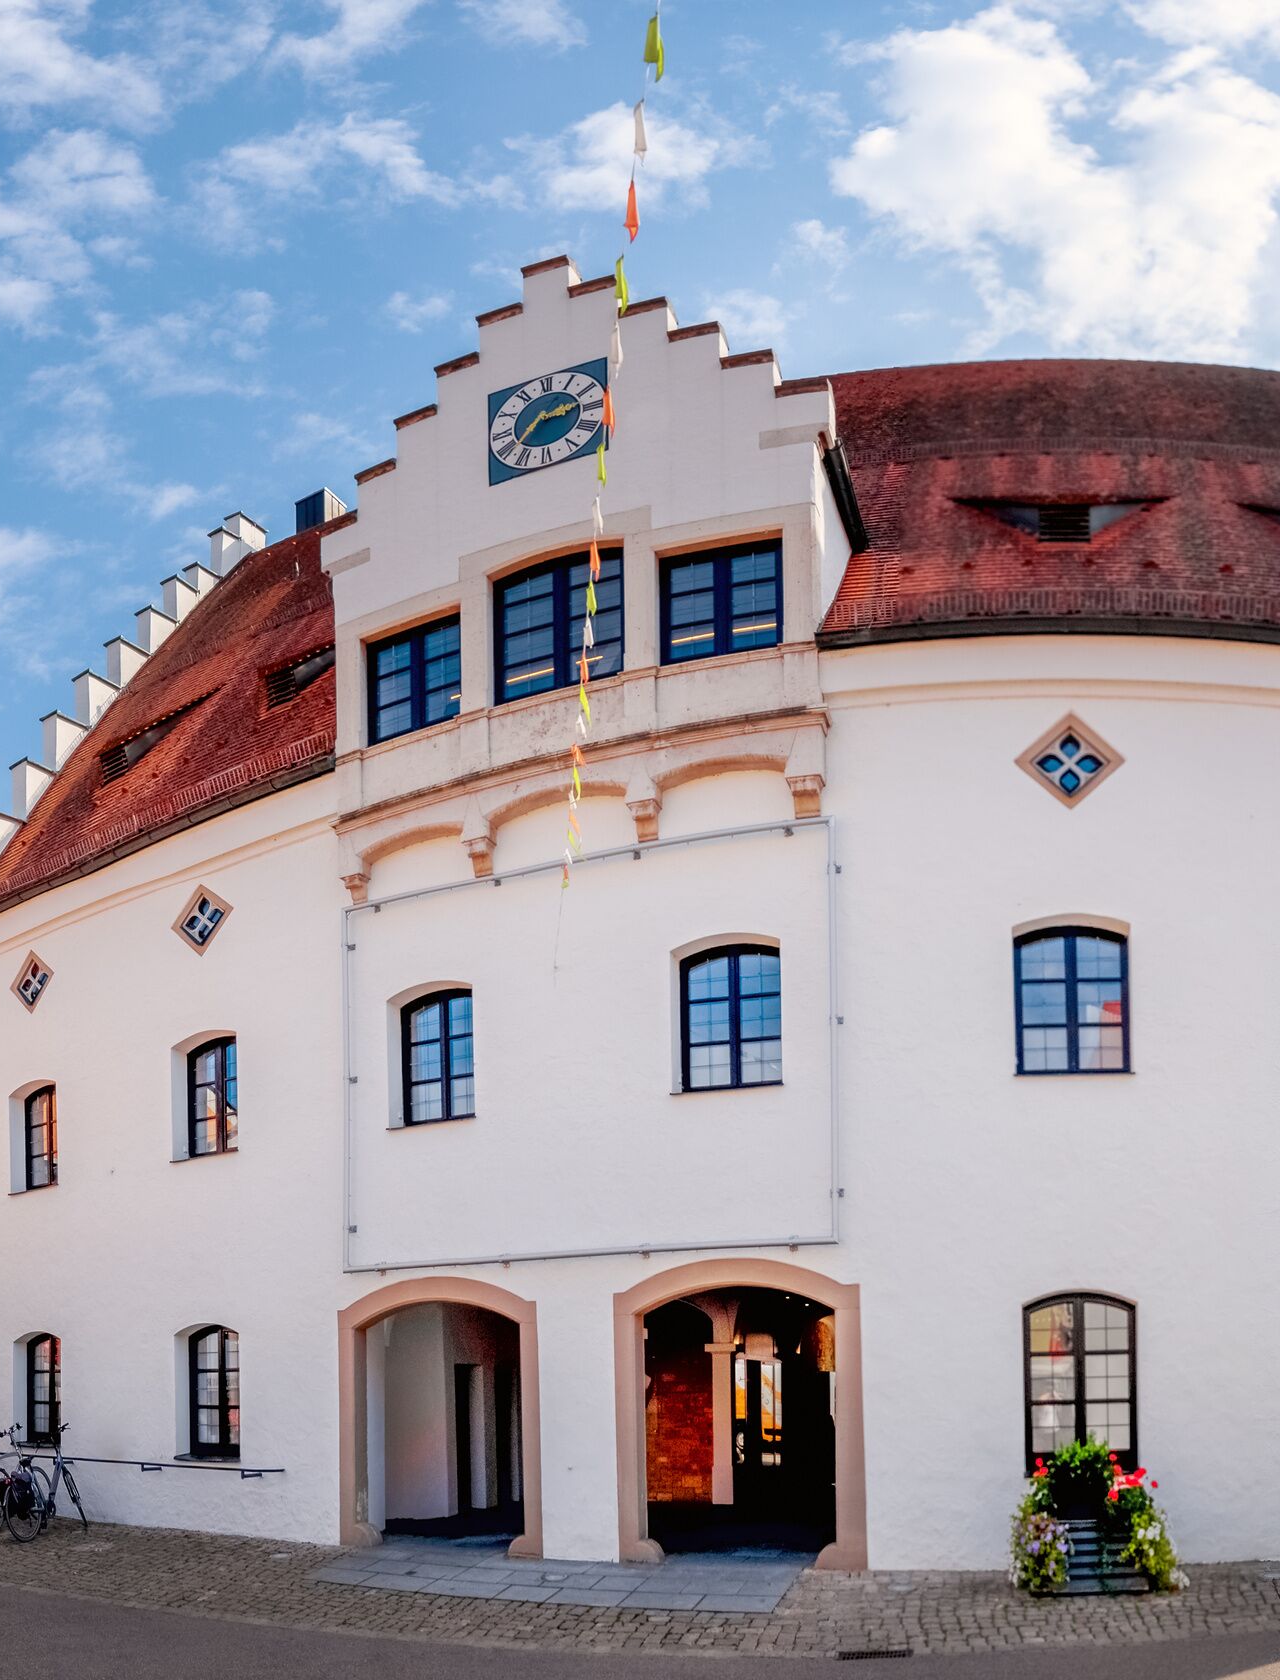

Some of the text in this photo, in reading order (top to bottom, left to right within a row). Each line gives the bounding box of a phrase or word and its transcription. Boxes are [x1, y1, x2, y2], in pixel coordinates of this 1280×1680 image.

[540, 376, 553, 394] XII
[563, 375, 577, 390] I
[576, 382, 597, 398] II
[516, 389, 532, 405] XI
[583, 399, 603, 412] III
[498, 411, 518, 419] X
[576, 419, 599, 433] IIII
[493, 428, 512, 441] IX
[497, 440, 517, 460] VIII
[565, 437, 580, 452] V
[514, 448, 532, 466] VII
[541, 447, 553, 464] VI
